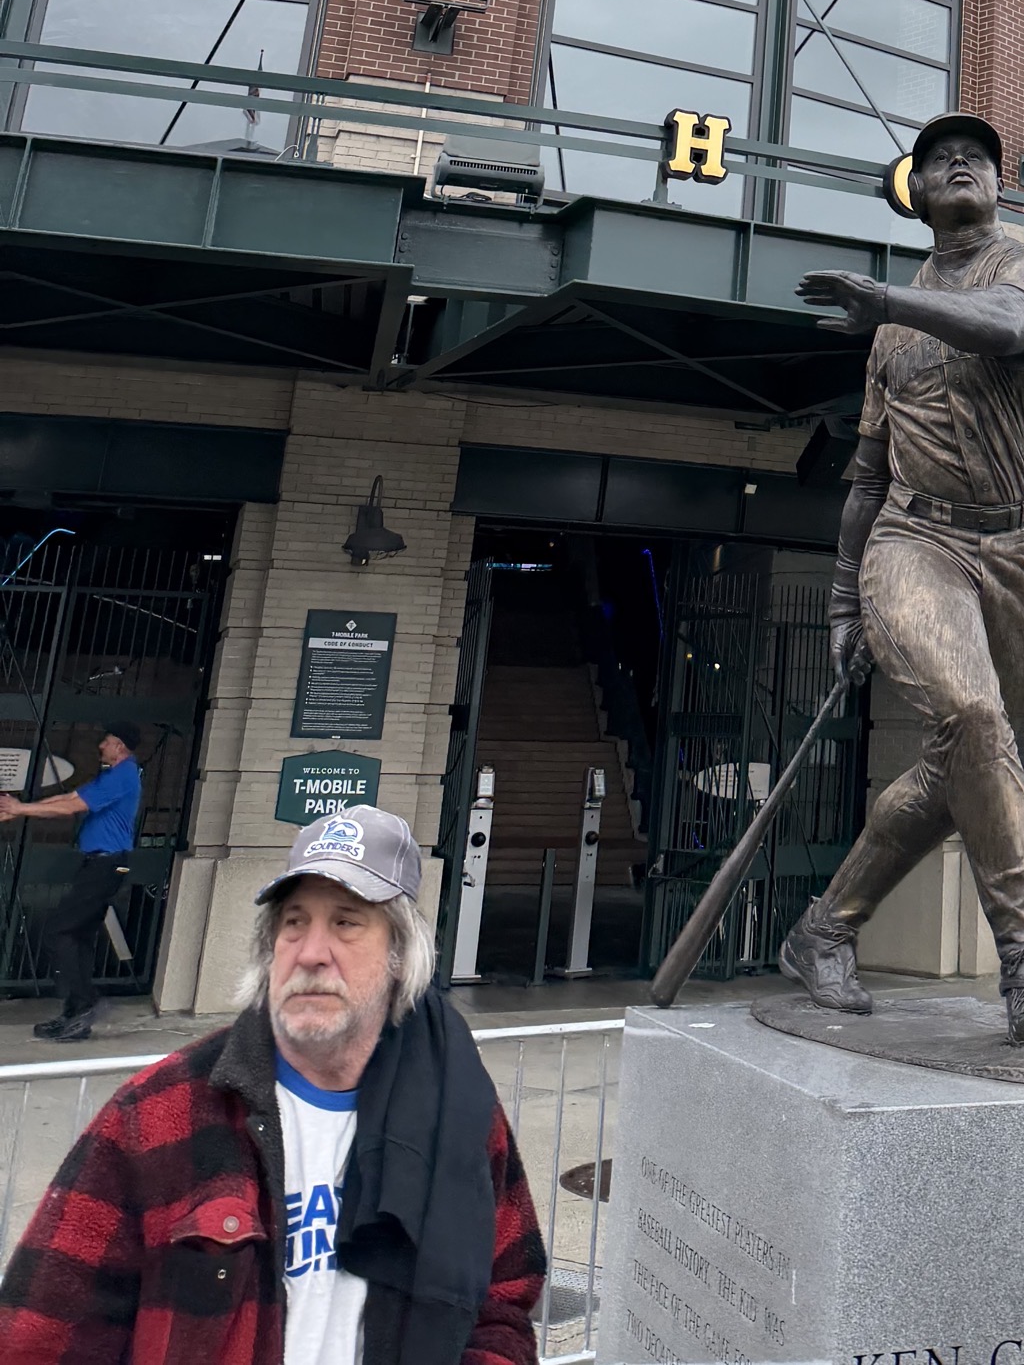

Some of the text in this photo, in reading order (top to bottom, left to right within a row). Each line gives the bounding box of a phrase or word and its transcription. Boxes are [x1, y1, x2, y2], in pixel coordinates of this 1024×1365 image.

[303, 767, 346, 775] WELCOME
[293, 779, 367, 795] T-MOBILE
[304, 799, 349, 814] PARK
[306, 841, 360, 857] SOUNDERS
[671, 1176, 687, 1207] THE
[689, 1190, 732, 1239] GREATEST
[735, 1221, 774, 1271] PLAYERS
[637, 1207, 673, 1255] BASEBALL
[764, 1307, 786, 1347] WAS
[633, 1259, 648, 1291] THE
[650, 1274, 669, 1310] FACE
[671, 1293, 682, 1321] OF
[684, 1304, 701, 1340] THE
[626, 1309, 644, 1343] TWO
